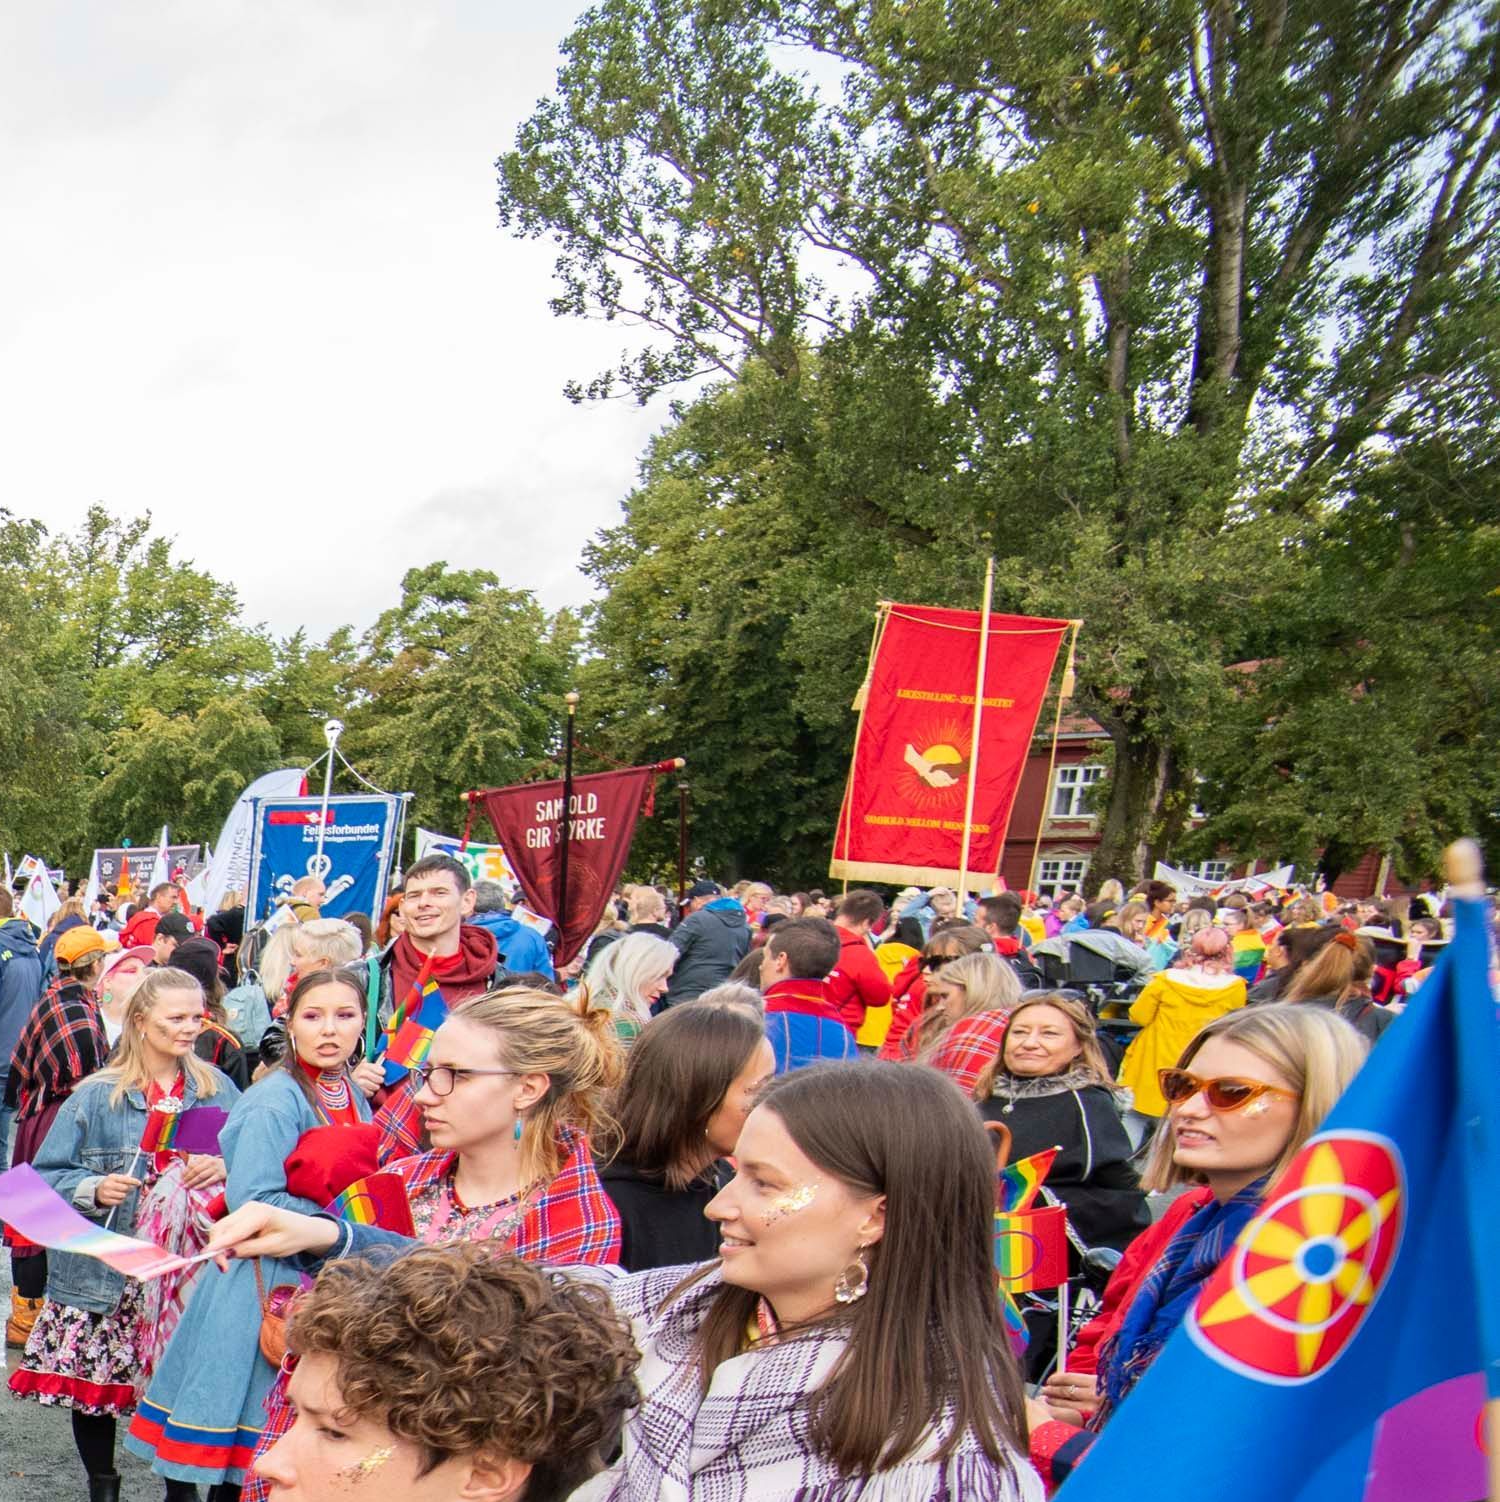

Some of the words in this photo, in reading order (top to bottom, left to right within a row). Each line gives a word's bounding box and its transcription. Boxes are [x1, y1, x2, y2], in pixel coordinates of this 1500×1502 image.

[535, 793, 598, 822] SAMOLD
[303, 824, 379, 836] Fellsforbundet
[526, 826, 552, 848] GIR
[555, 817, 606, 844] SYRKE
